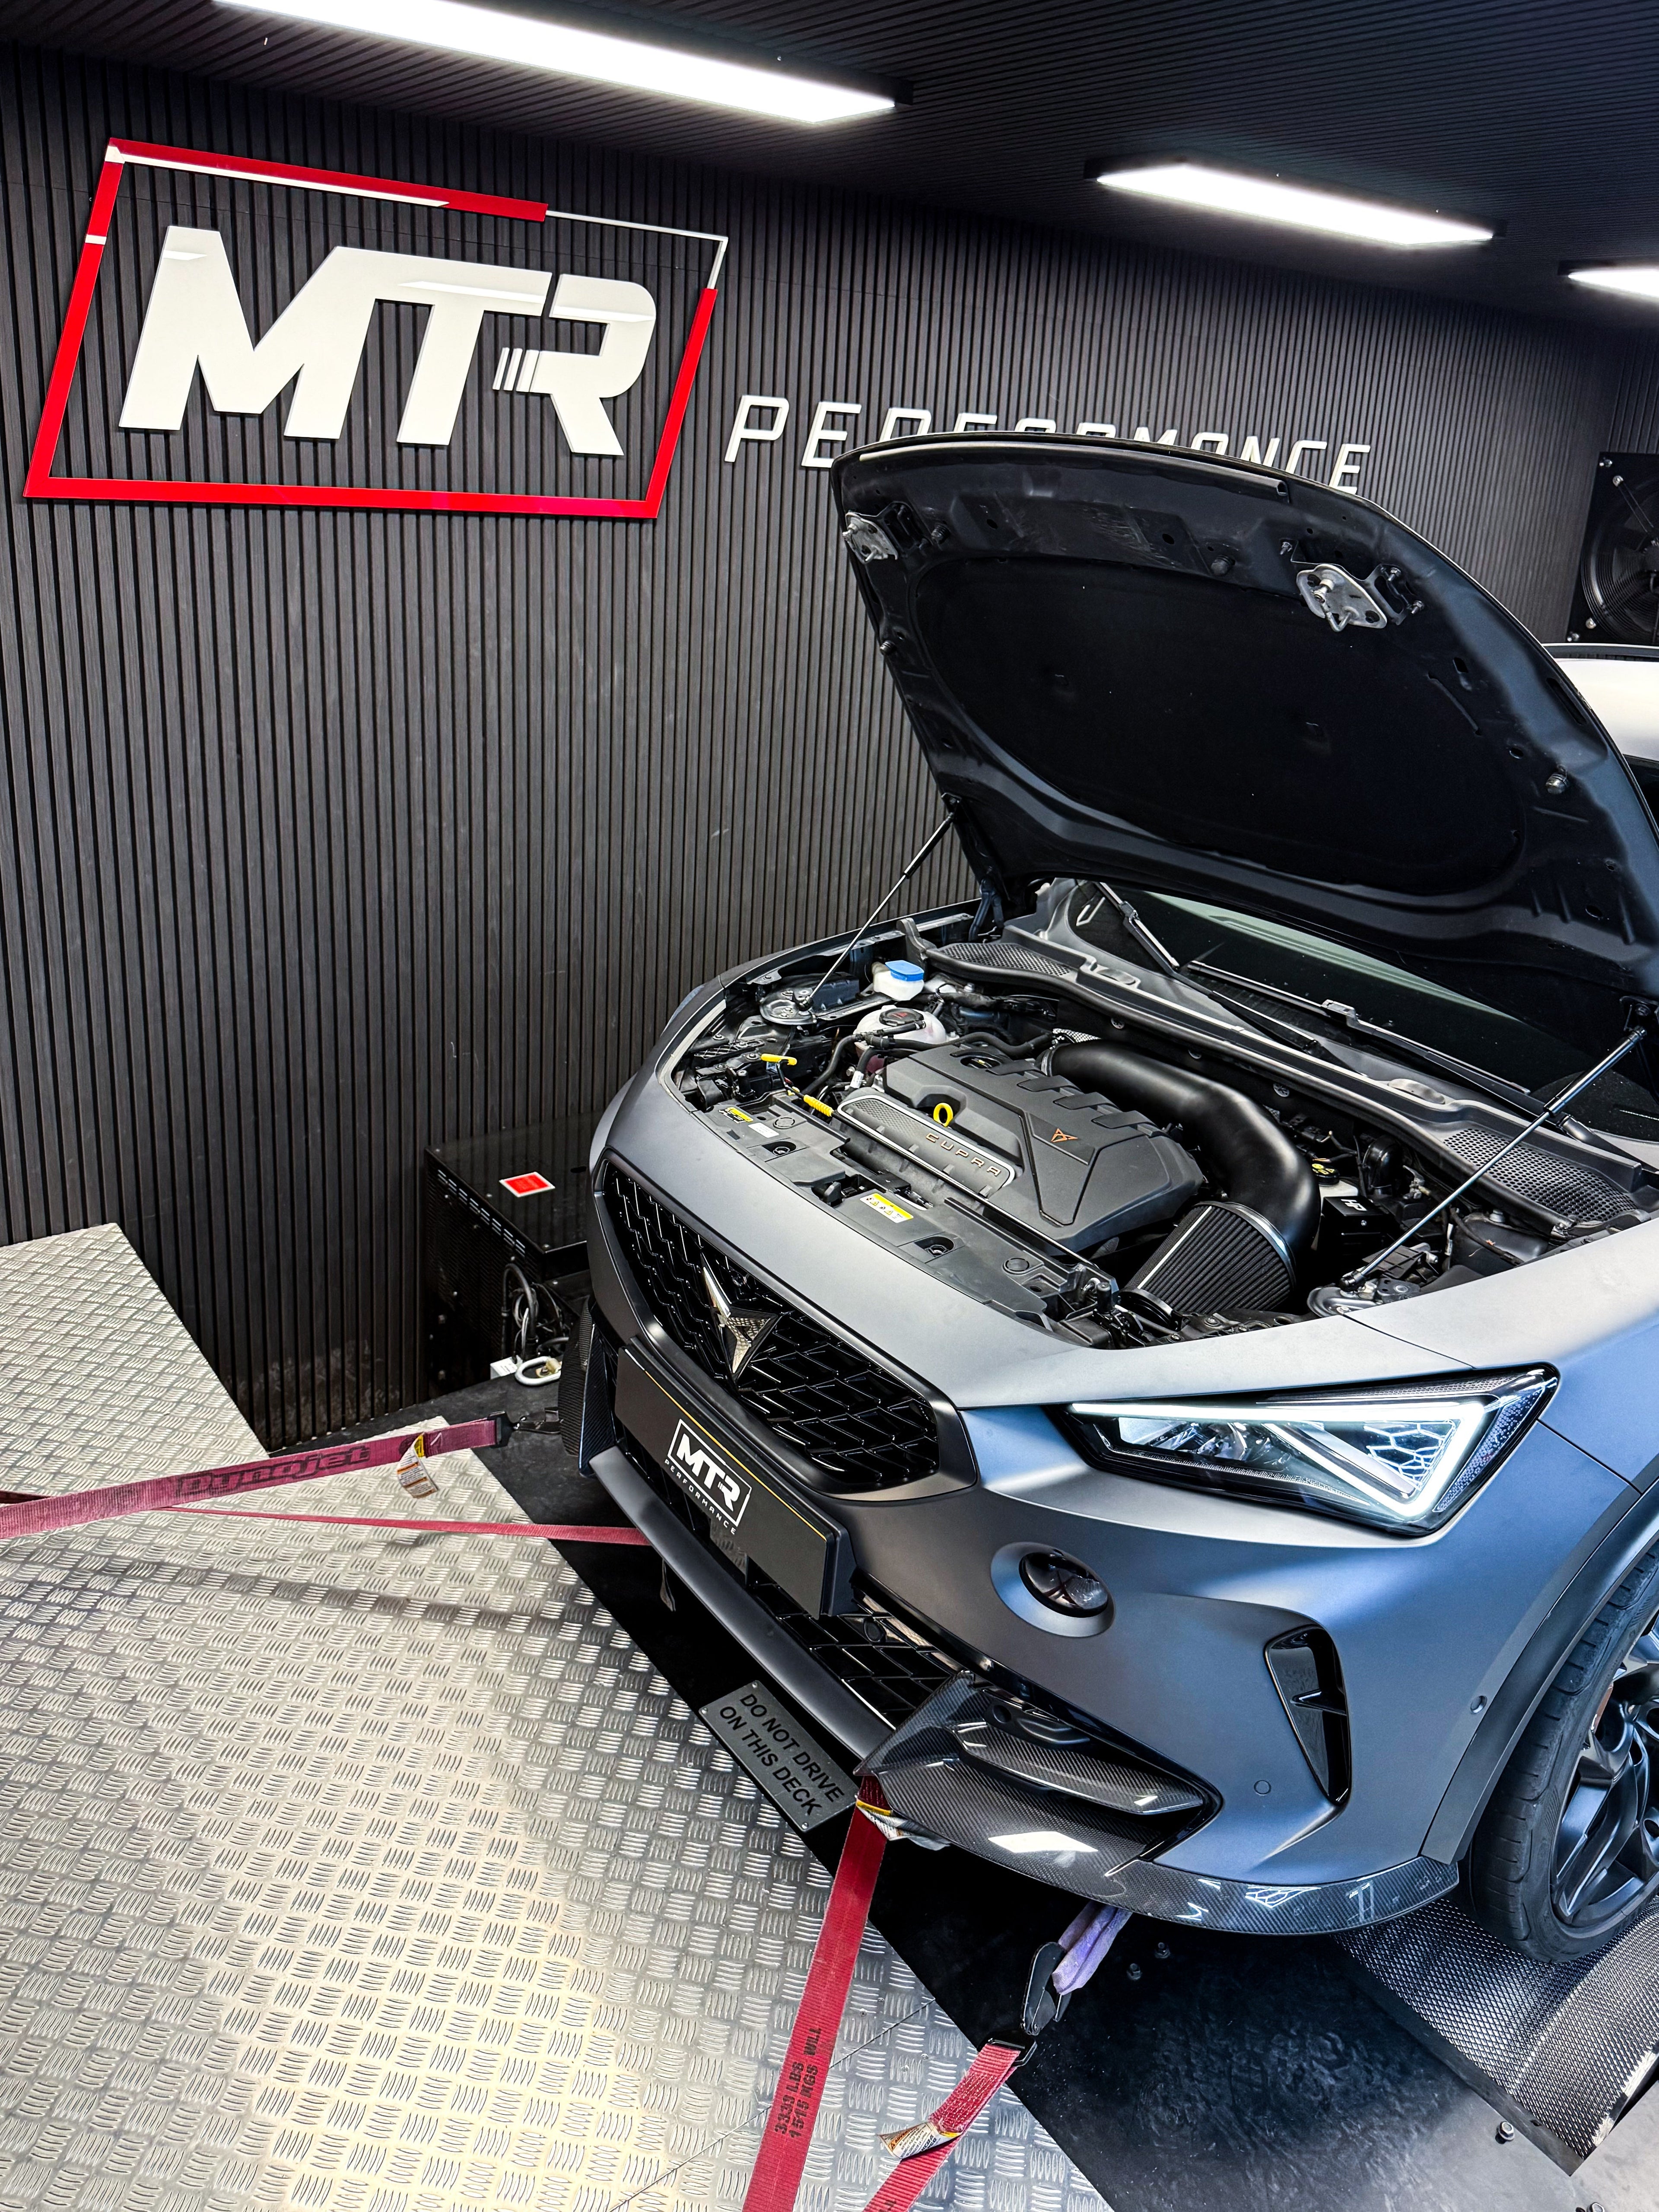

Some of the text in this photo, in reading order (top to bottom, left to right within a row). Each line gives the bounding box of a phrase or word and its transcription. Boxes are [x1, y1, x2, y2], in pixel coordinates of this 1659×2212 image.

[118, 225, 657, 456] MTR
[725, 395, 1371, 494] PERNCE
[926, 1133, 1001, 1176] CUPRA
[177, 1446, 370, 1497] Dynojet
[664, 1459, 736, 1535] PERFORMANCE
[676, 1433, 740, 1512] MTR
[720, 1706, 822, 1815] ON THIS DECK
[740, 1694, 845, 1802] DO NOT DRIVE
[786, 2062, 804, 2092] LBS
[804, 2028, 822, 2056] WLL
[789, 2064, 818, 2138] 1515 KGS
